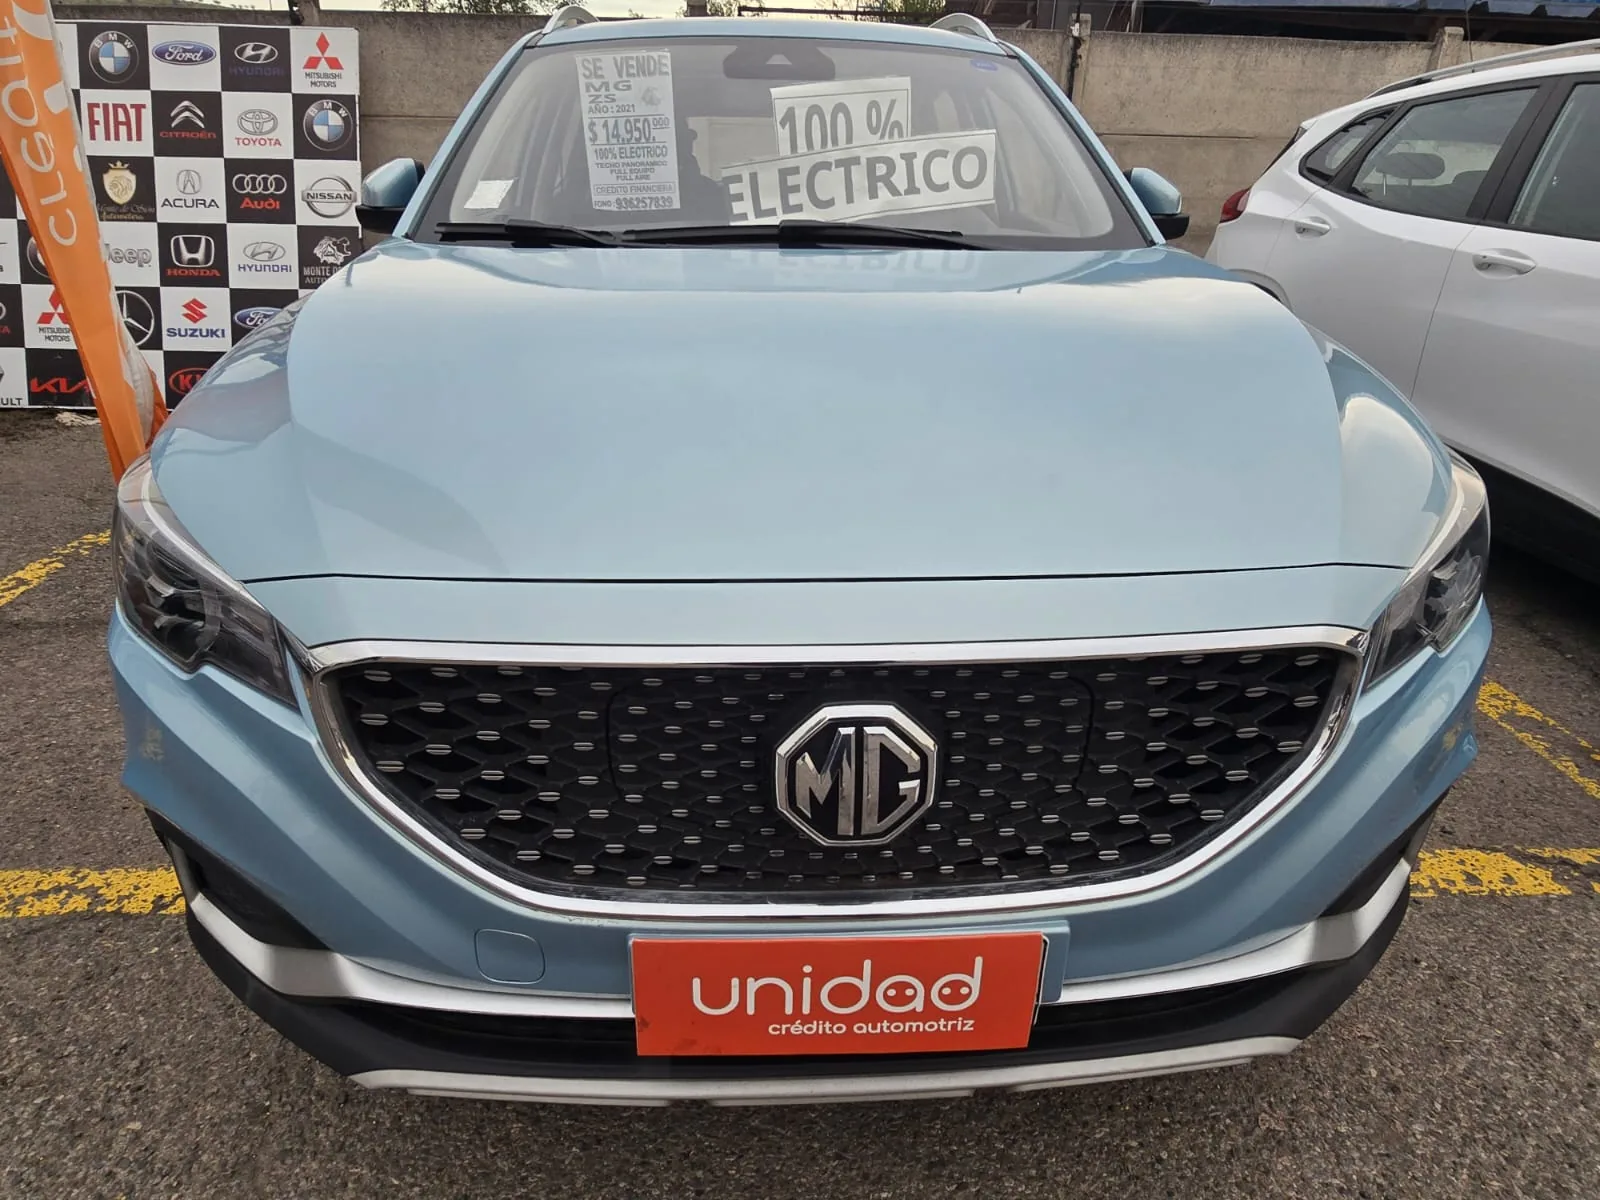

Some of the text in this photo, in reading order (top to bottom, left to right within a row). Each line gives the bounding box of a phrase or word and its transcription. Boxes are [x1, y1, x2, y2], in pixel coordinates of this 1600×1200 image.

[165, 45, 204, 61] Ford
[229, 66, 284, 76] HYUNDAI
[582, 55, 670, 79] SE VENDE
[305, 72, 342, 80] MITSUBISHI
[584, 80, 632, 92] MG
[588, 94, 617, 104] ZS
[616, 104, 636, 113] 2021
[87, 103, 147, 142] FIAT
[779, 98, 904, 154] 100 %
[235, 137, 281, 147] TOYOTA
[594, 145, 668, 160] 100% ELECTRICO
[722, 145, 988, 222] ELECTRICO
[595, 186, 629, 194] CREDITO
[306, 192, 352, 200] NISSAN
[161, 198, 219, 209] ACURA
[240, 197, 280, 209] Audi
[166, 268, 221, 277] HONDA
[238, 264, 292, 272] HYUNDAI
[304, 265, 331, 276] MONTE
[167, 328, 226, 338] SUZUKI
[796, 726, 921, 836] MG
[692, 956, 983, 1015] unidad
[768, 1017, 975, 1035] crédito automotriz
